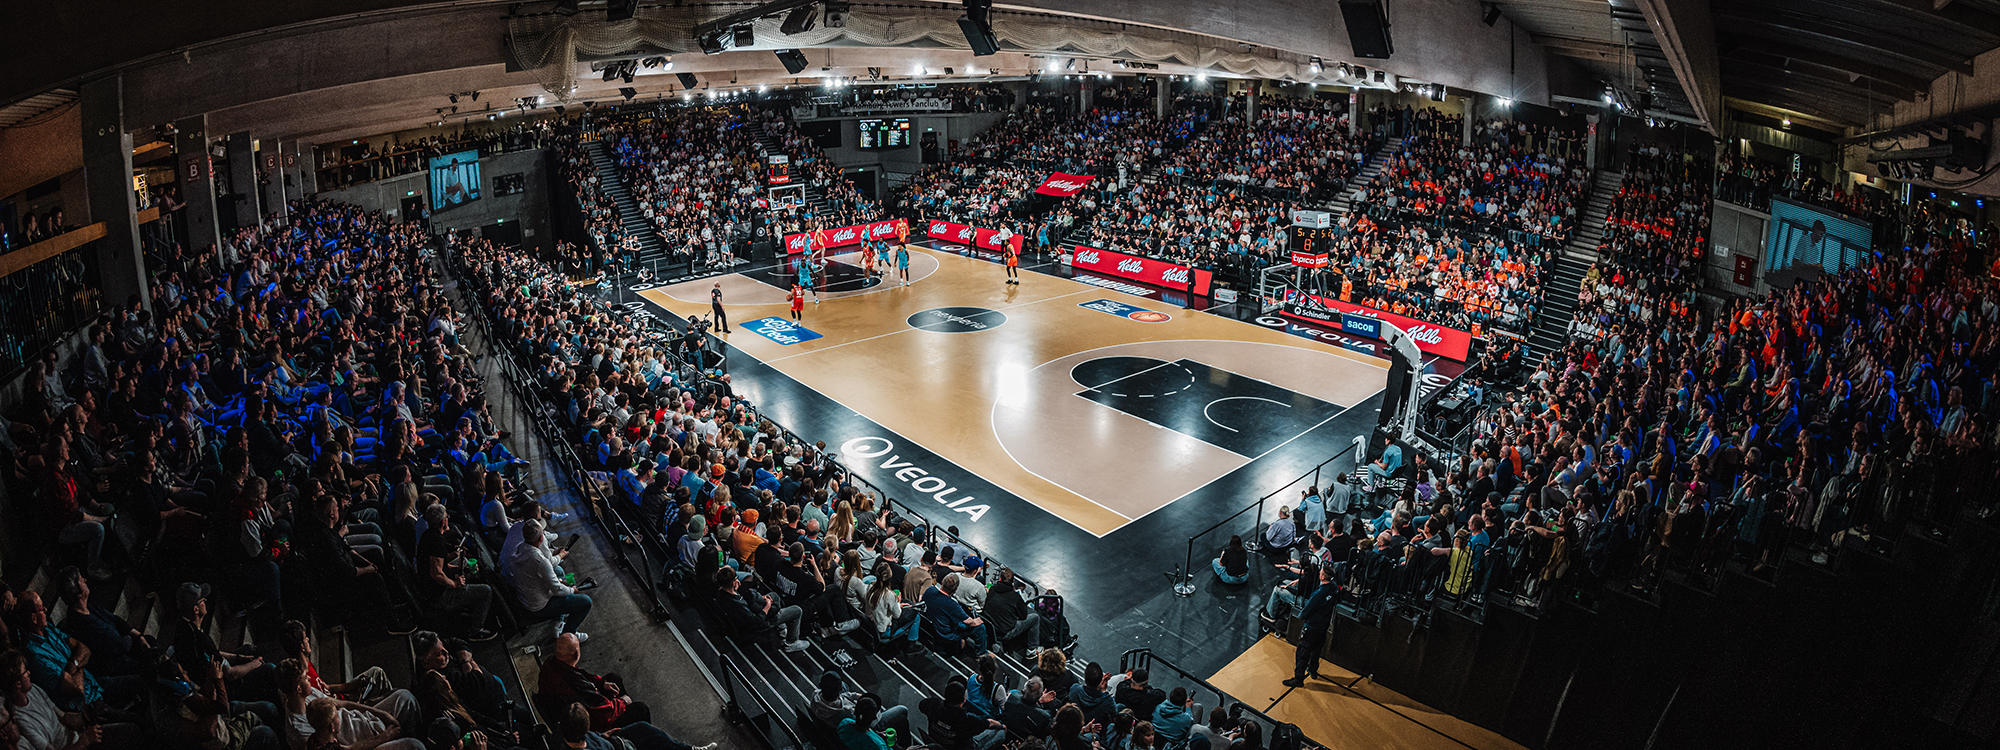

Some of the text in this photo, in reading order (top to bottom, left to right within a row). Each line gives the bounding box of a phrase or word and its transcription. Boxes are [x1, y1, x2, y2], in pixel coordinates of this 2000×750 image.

[911, 100, 939, 108] Fanclub
[268, 158, 274, 167] C
[190, 164, 198, 177] B
[833, 228, 856, 243] Kello
[872, 222, 894, 236] Kello
[931, 223, 948, 234] Kello
[1304, 238, 1311, 251] 8
[1076, 249, 1100, 264] Kello
[1293, 254, 1315, 264] tipico
[1117, 258, 1143, 273] Kello
[1162, 267, 1189, 283] Kello
[929, 310, 987, 329] nexperia
[1302, 309, 1331, 320] Schindler
[760, 318, 798, 331] easy
[757, 326, 801, 344] Credit
[1292, 325, 1376, 352] VEOLIA
[1407, 324, 1442, 345] Kello
[879, 454, 991, 523] VEOLIA
